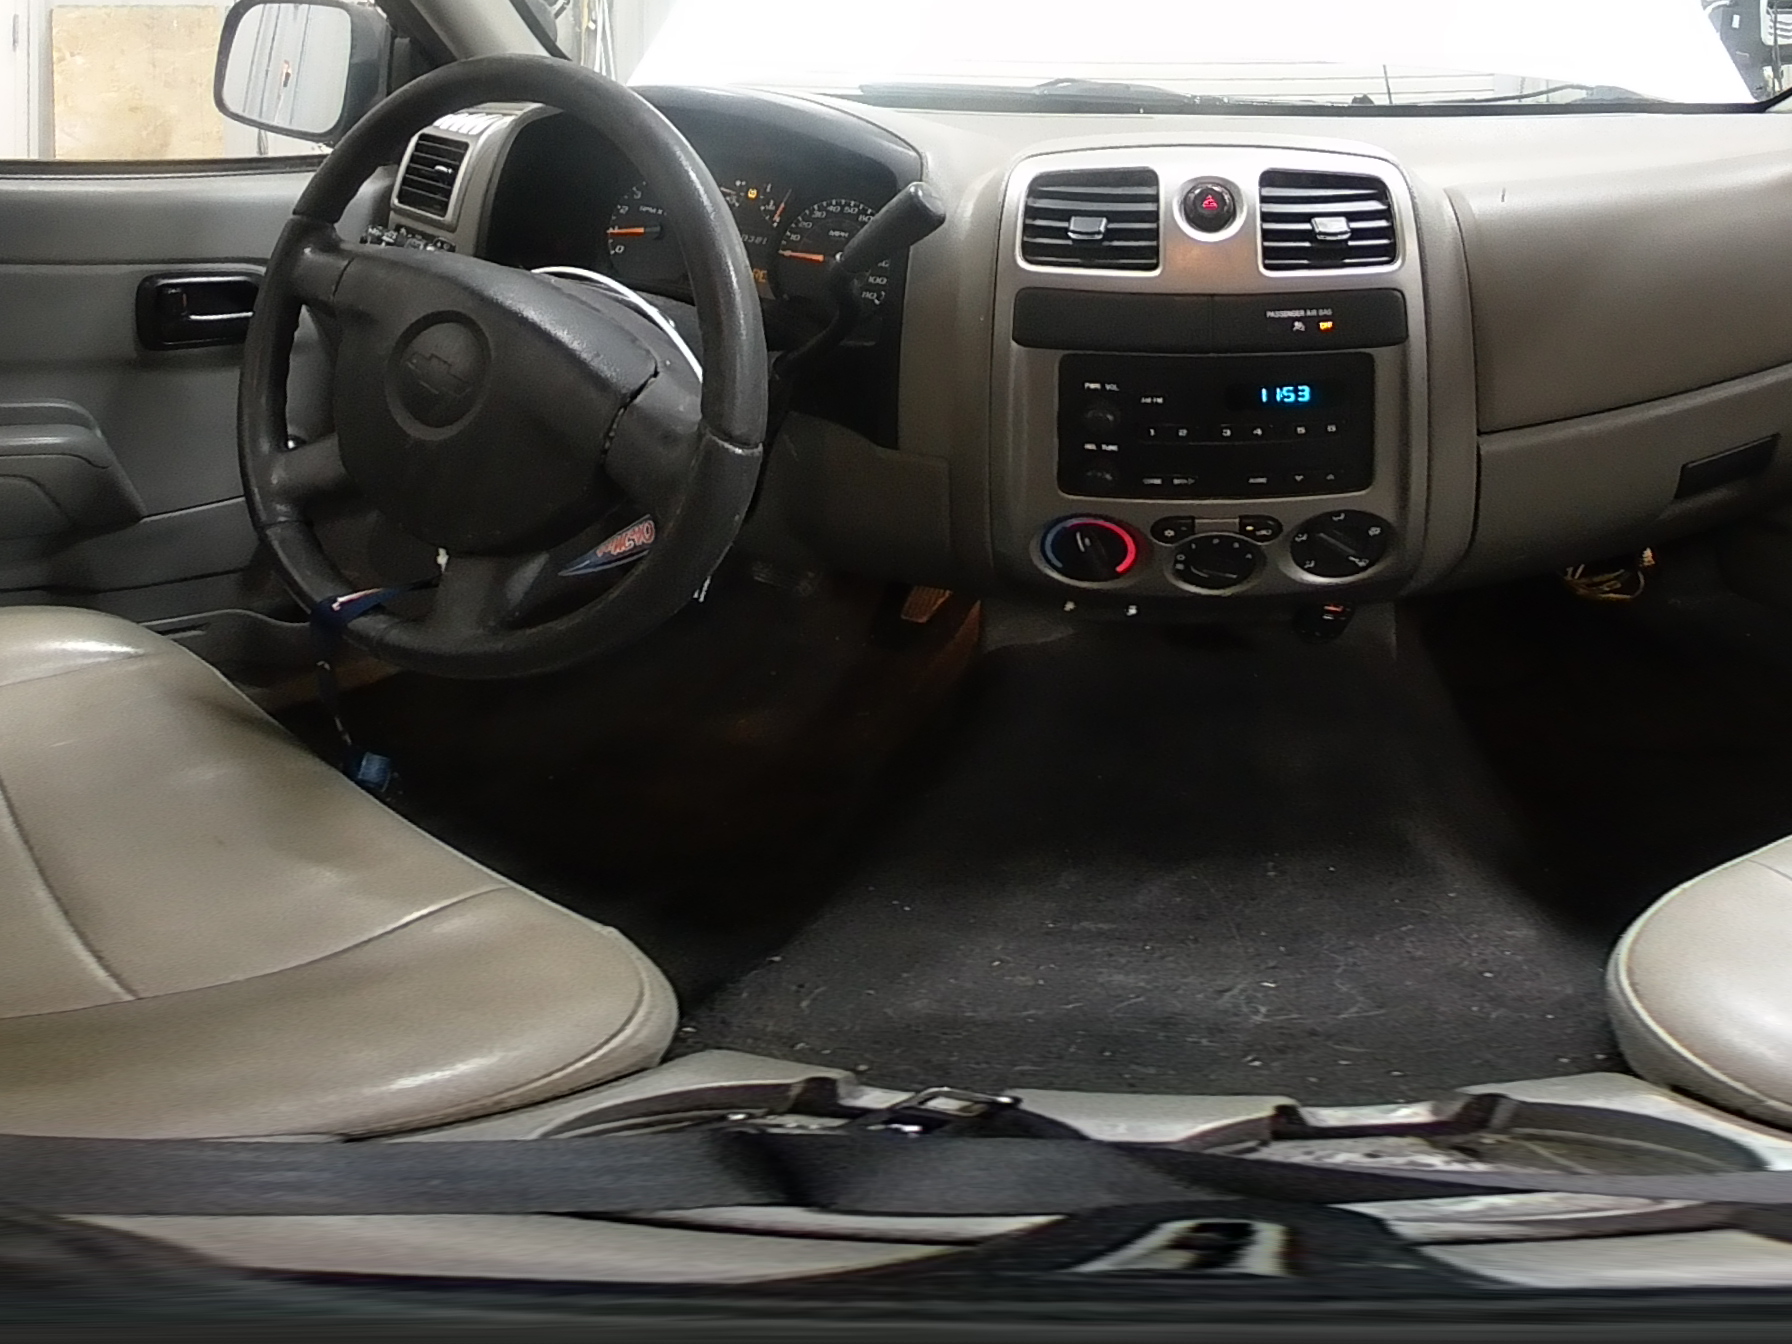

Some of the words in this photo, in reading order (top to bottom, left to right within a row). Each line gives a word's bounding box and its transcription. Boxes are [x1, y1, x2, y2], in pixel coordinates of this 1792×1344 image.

[868, 275, 887, 285] 100
[1266, 309, 1305, 318] PASSENGER
[1221, 428, 1232, 437] 3
[1253, 428, 1263, 436] 4
